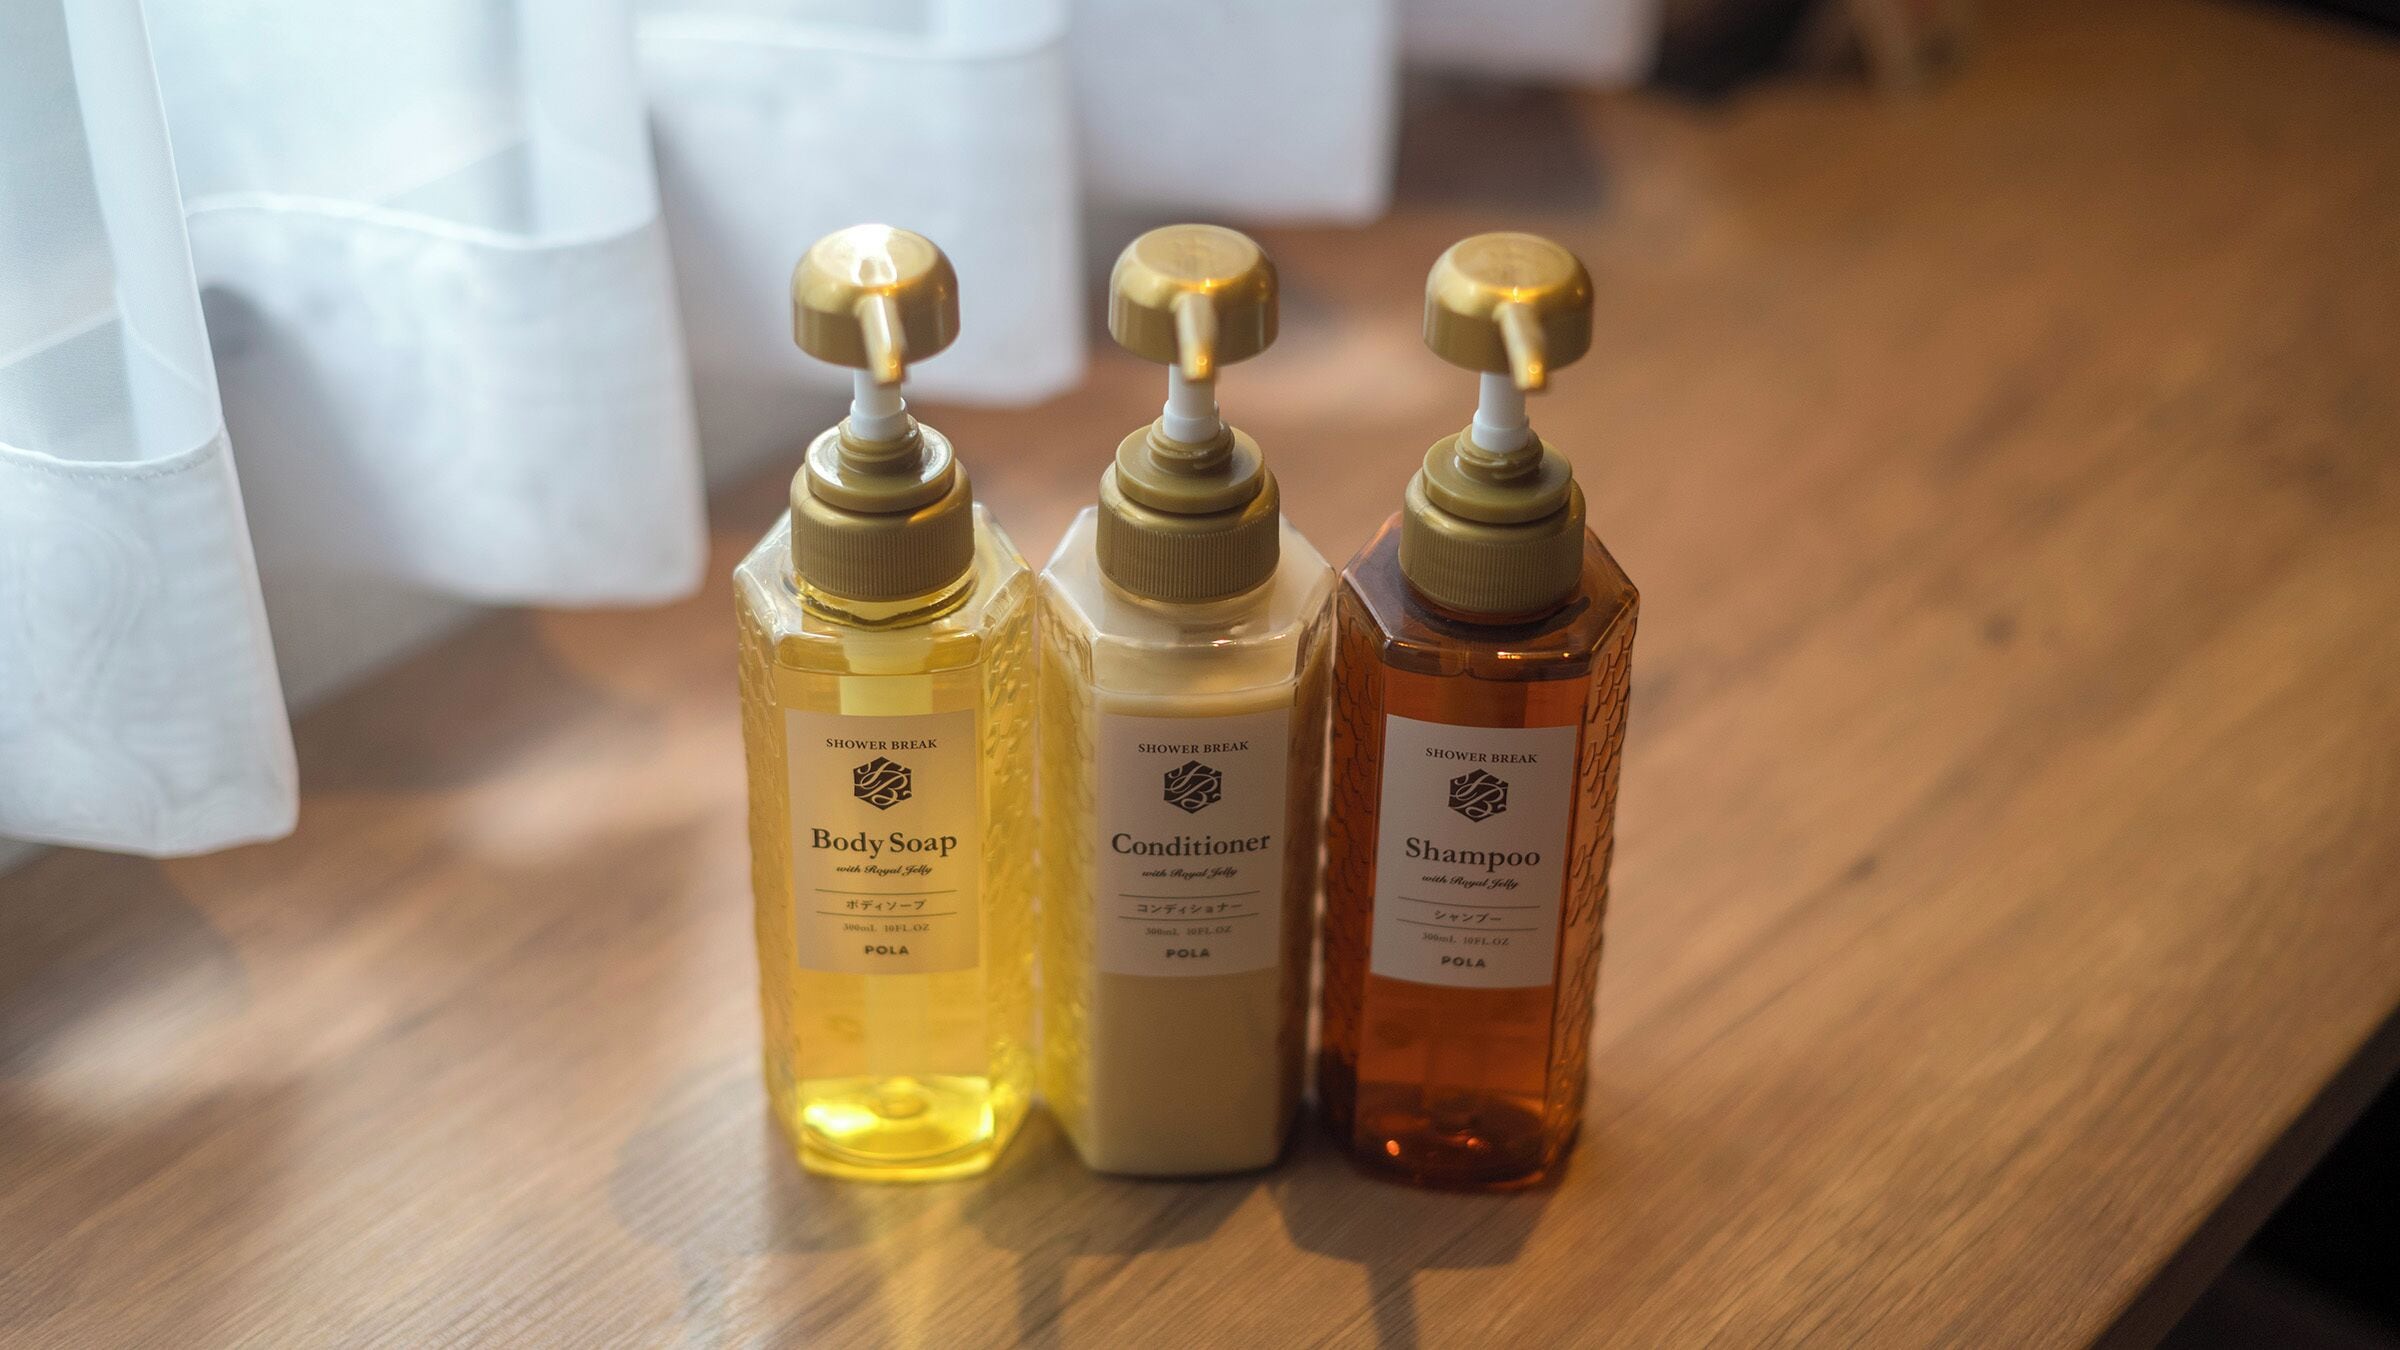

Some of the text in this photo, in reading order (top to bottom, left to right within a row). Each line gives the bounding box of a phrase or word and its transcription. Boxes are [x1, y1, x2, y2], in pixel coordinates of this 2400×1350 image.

[826, 738, 938, 750] SHOWER BREAK
[1138, 740, 1249, 754] SHOWER BREAK
[1425, 747, 1538, 764] SHOWER BREAK
[811, 827, 957, 859] Body Soap
[1111, 832, 1271, 857] Conditioner
[1405, 836, 1541, 873] Shampoo
[836, 864, 933, 877] with Royal Jelly
[1142, 867, 1238, 880] with Royal Jelly
[1421, 875, 1519, 890] with Royal Jelly
[1137, 902, 1243, 914] コンディショナー
[864, 945, 909, 955] POLA
[1166, 948, 1210, 958] POLA
[1441, 955, 1486, 968] POLA
